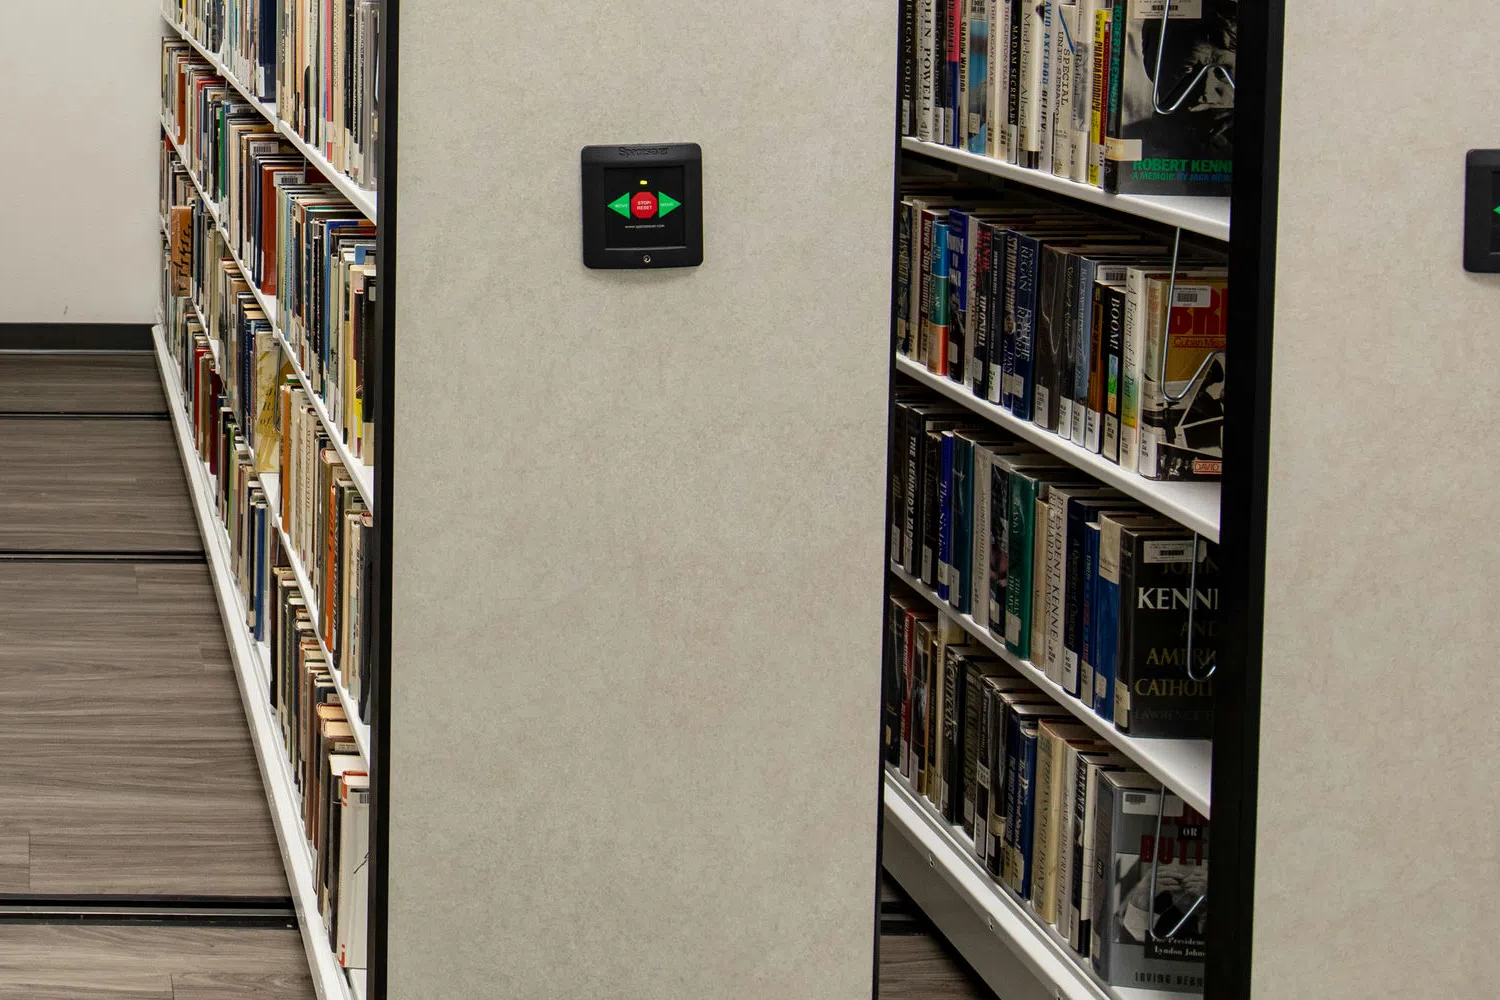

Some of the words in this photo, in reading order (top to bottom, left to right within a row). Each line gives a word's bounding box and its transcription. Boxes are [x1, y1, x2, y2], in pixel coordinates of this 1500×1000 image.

[923, 49, 931, 116] POWELL
[1061, 48, 1069, 106] SPECIAL
[921, 274, 929, 313] Running
[1110, 298, 1120, 349] BOOM!
